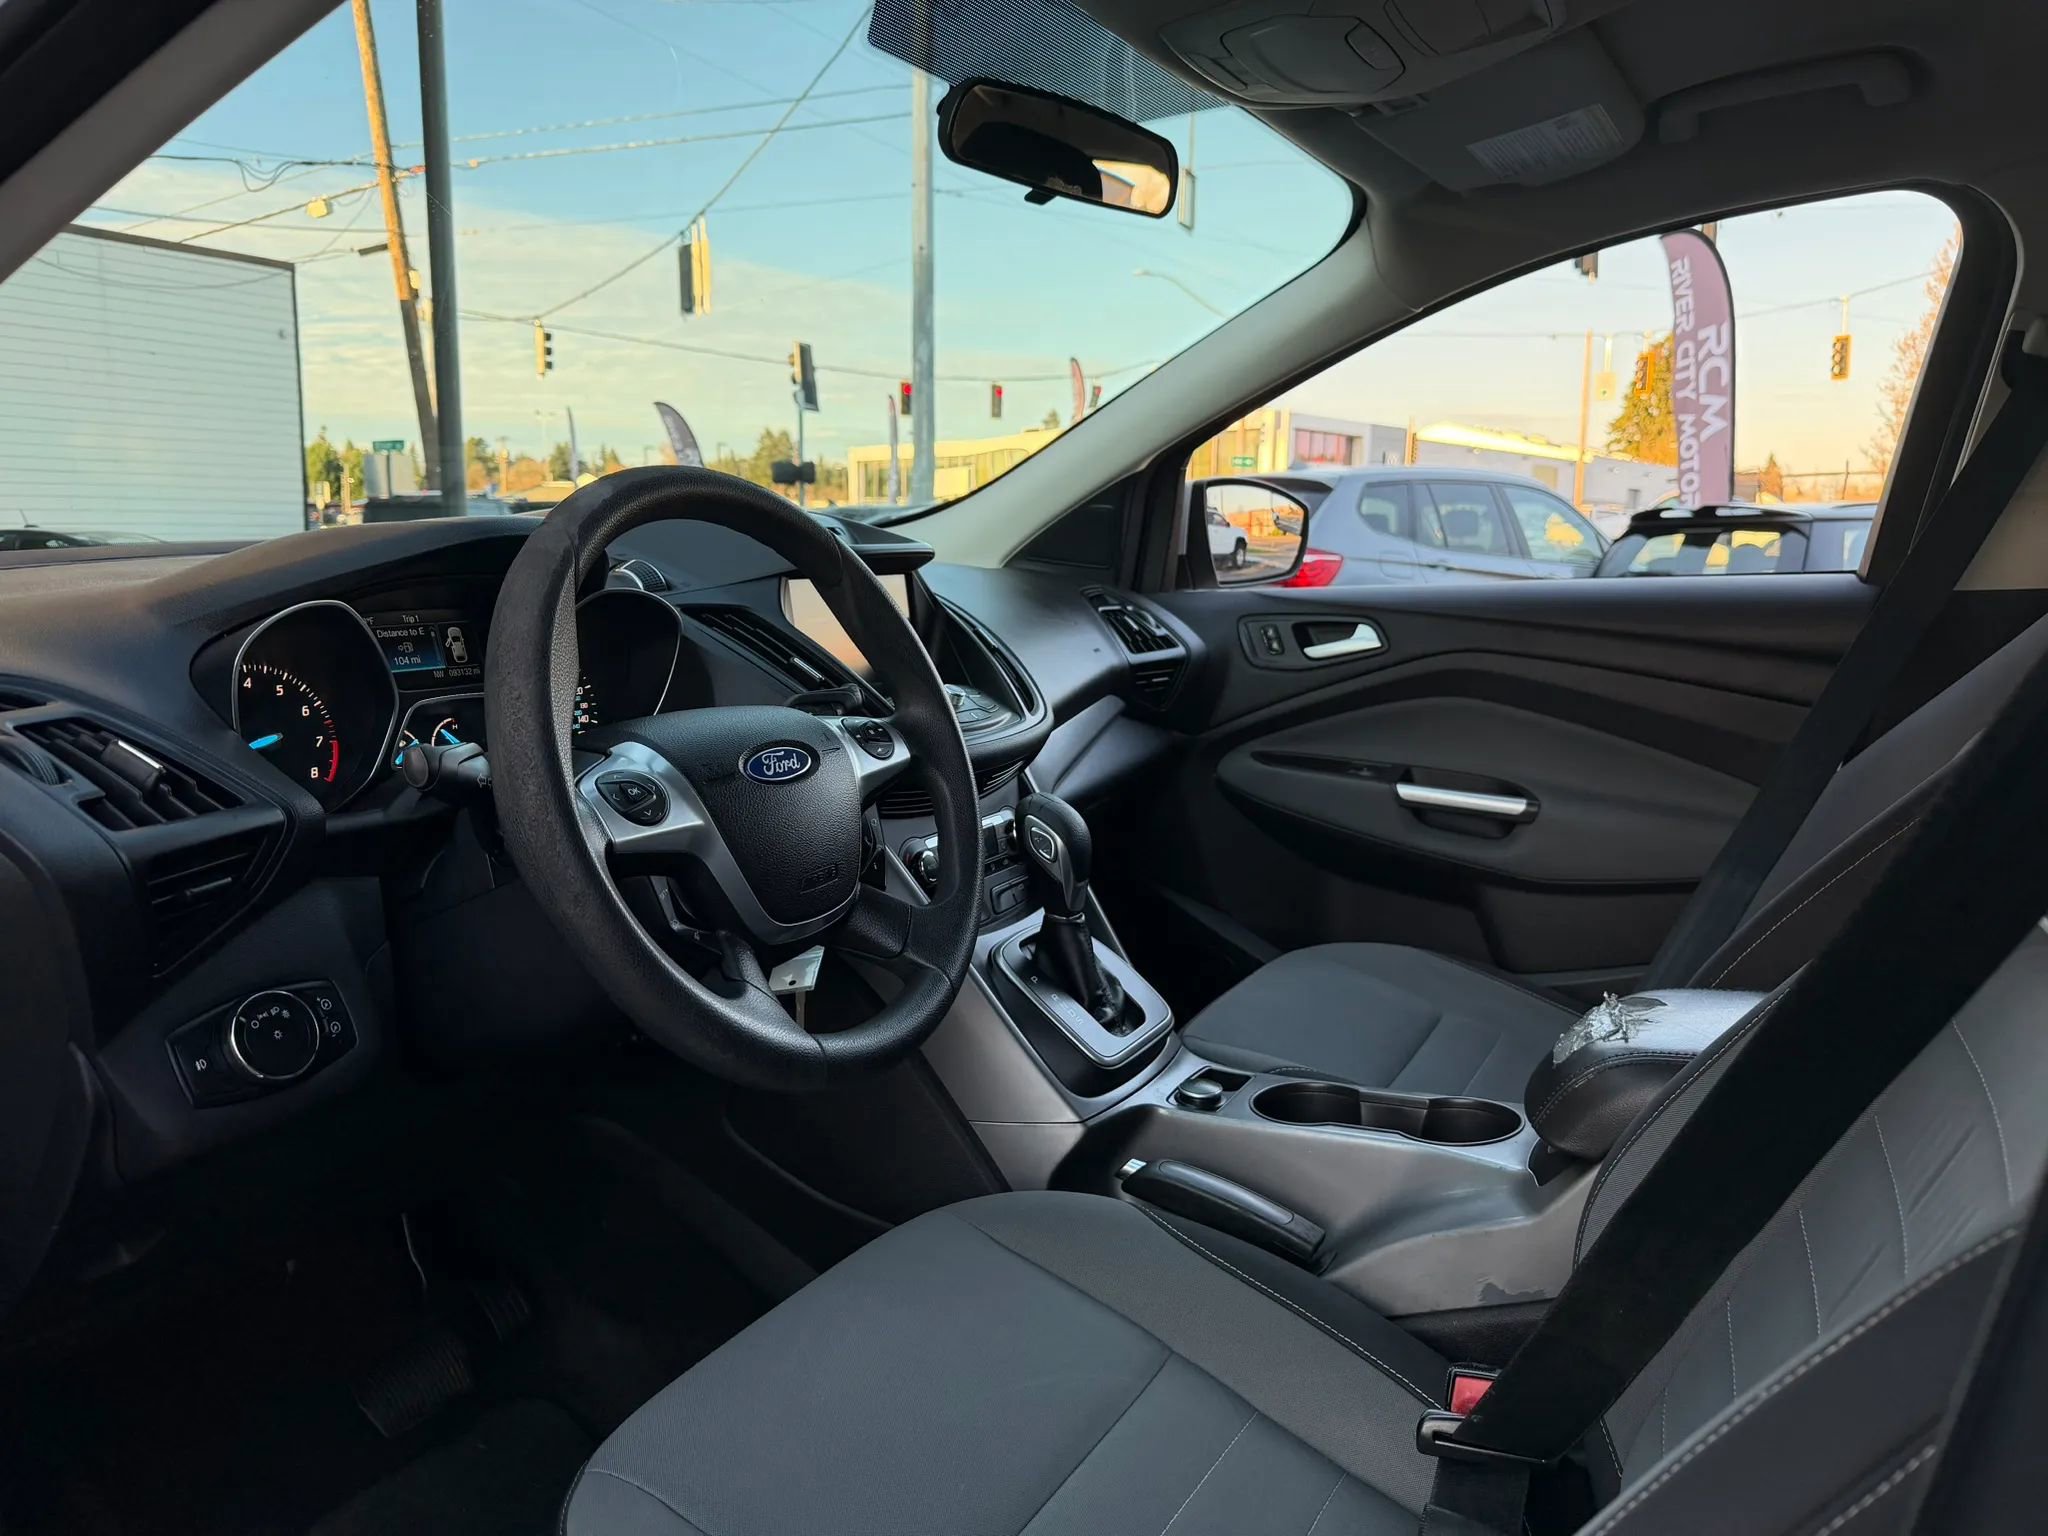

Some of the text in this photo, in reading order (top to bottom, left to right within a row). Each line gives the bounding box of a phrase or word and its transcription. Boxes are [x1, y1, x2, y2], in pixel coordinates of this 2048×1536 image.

[1671, 256, 1695, 336] RIVER
[1675, 341, 1697, 400] CITY
[1698, 320, 1729, 442] RCM
[402, 615, 415, 624] Trip
[377, 629, 409, 638] Distance
[419, 627, 425, 635] E
[394, 655, 421, 665] 104 mi
[243, 677, 252, 688] 4
[276, 684, 284, 696] 5
[302, 705, 310, 716] 6
[577, 714, 590, 723] 140
[316, 736, 324, 748] 7
[761, 750, 801, 776] Ford
[311, 767, 319, 778] 8
[627, 787, 641, 796] OK
